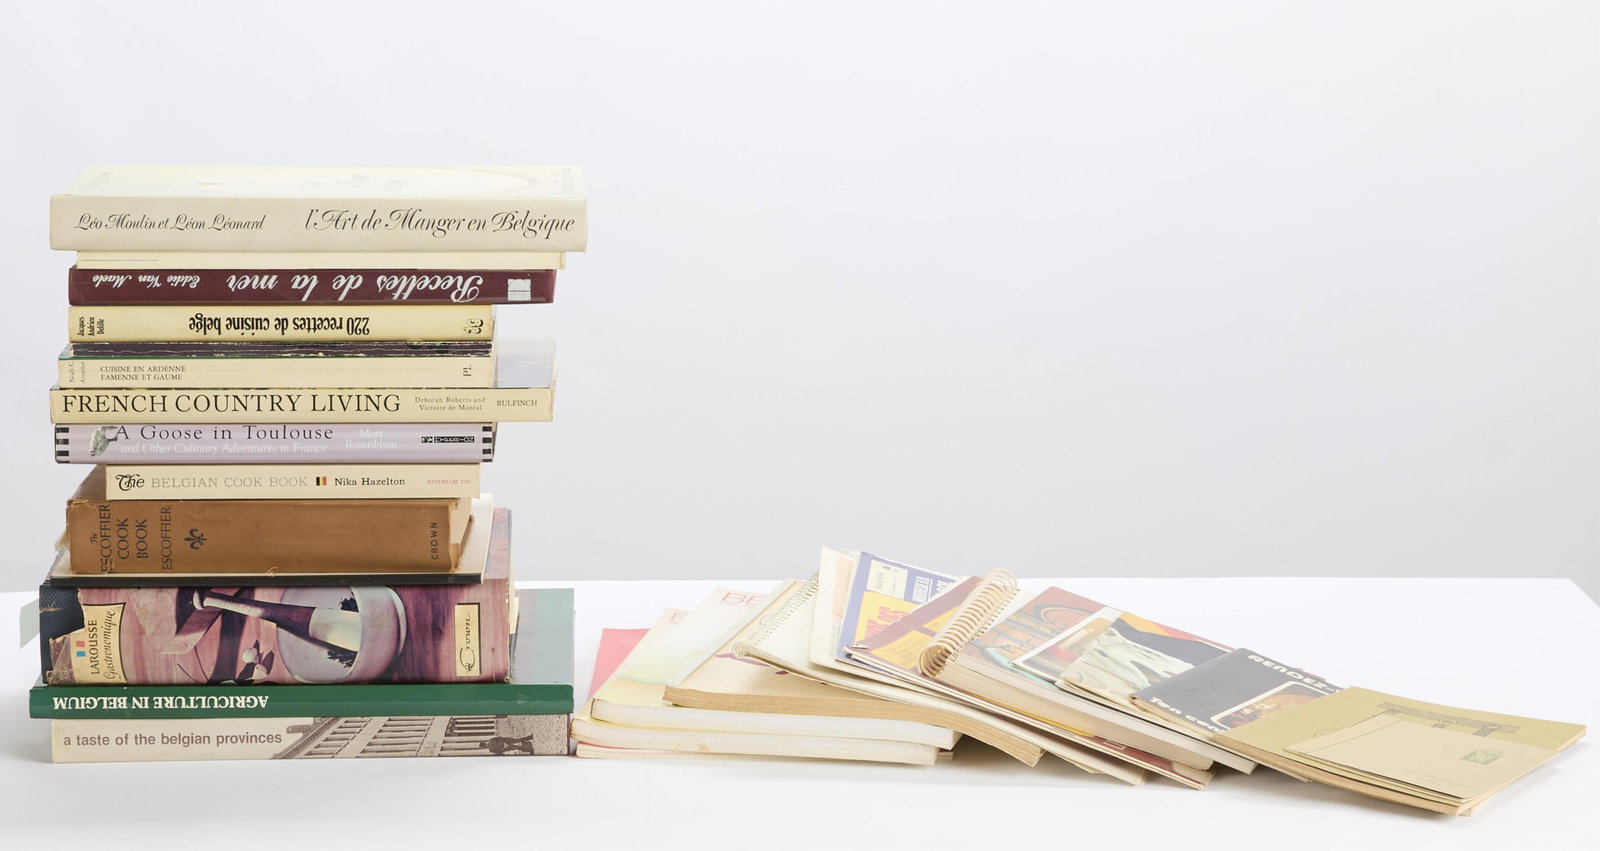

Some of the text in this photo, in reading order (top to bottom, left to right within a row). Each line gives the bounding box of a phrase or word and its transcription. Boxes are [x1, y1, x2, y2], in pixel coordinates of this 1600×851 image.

[74, 213, 266, 231] Léo Moulin et Léon Léonard
[361, 209, 382, 230] de
[385, 207, 466, 238] Manger
[467, 217, 487, 231] en
[491, 210, 575, 240] Belgique
[92, 275, 201, 288] Eddie Van Maele
[226, 275, 484, 303] Recettes de la mer
[77, 316, 85, 337] Jacques
[87, 316, 95, 337] Andrieu
[188, 312, 370, 335] 220 recettes de cuisine belge
[62, 394, 401, 413] FRENCH COUNTRY LIVING
[115, 425, 334, 440] A Goose in Toulouse
[359, 429, 383, 439] Mort
[120, 443, 327, 455] and Other Culinary Adventures in France
[345, 439, 397, 449] Rosenblum
[115, 473, 308, 492] The BELGIAN COOK BOOK
[334, 477, 405, 486] Nika Hazelton
[90, 533, 98, 544] The
[100, 503, 112, 572] ESCOFFIER
[117, 518, 130, 560] COOK
[135, 518, 148, 559] BOOK
[160, 506, 173, 570] ESCOFFIER
[431, 521, 439, 560] CROWN
[87, 620, 100, 675] LAROUSSE
[103, 607, 117, 680] Gastronomique
[53, 695, 269, 709] AGRICULTURE IN BELGIUM
[64, 730, 282, 747] a taste of the belgian provinces
